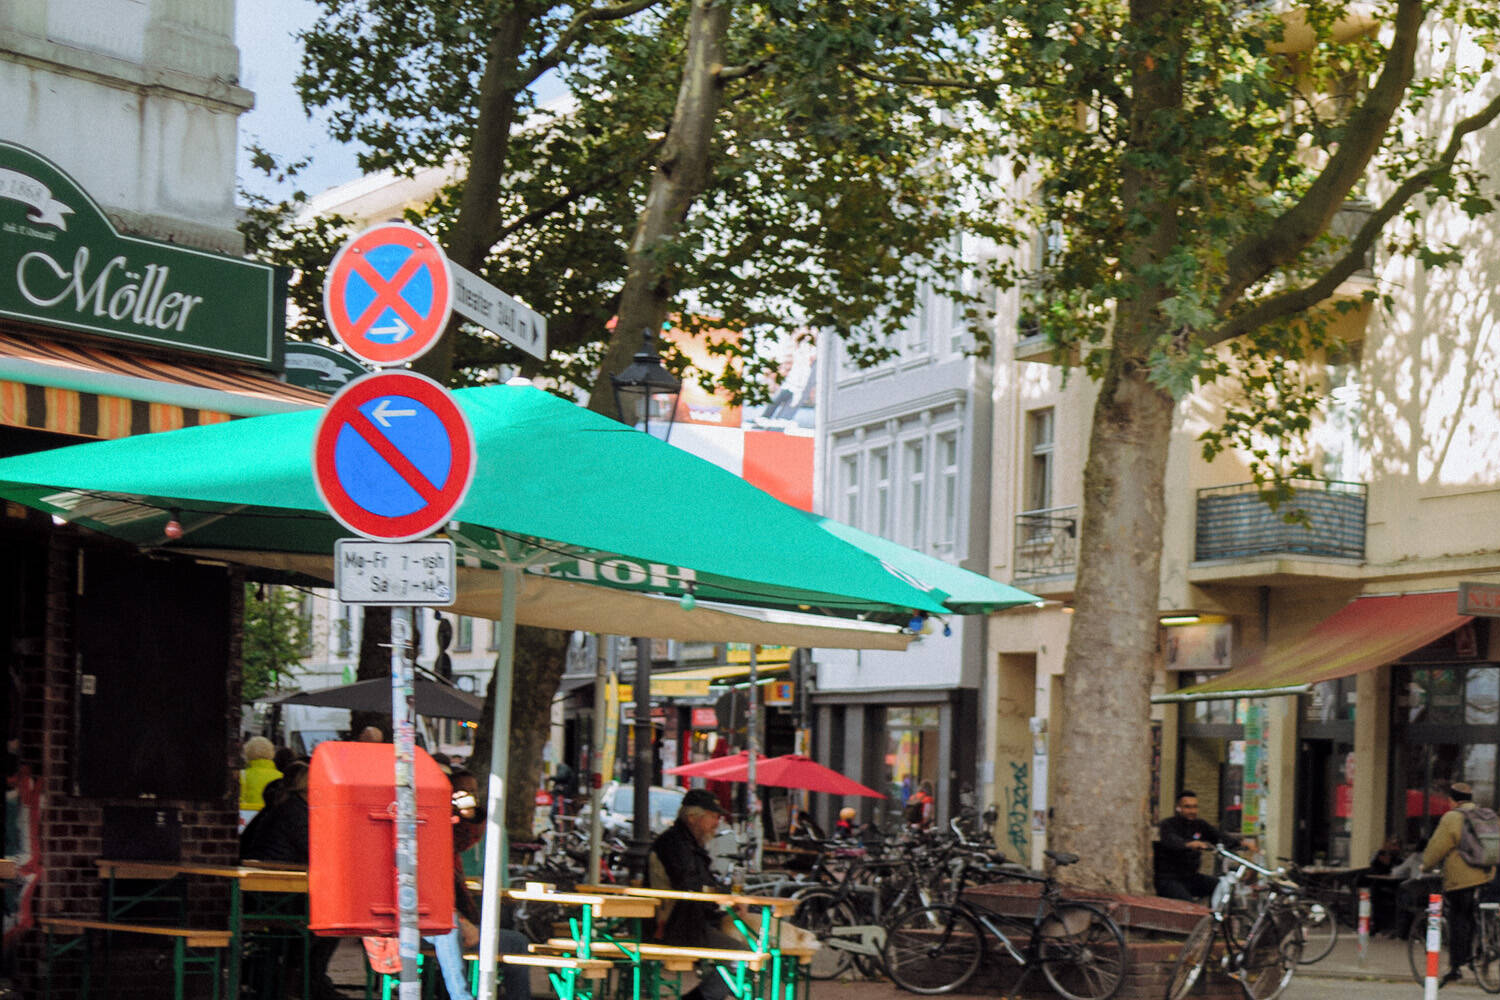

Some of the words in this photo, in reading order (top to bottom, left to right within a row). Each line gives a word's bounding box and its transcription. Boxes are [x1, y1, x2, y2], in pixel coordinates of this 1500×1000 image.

[17, 246, 203, 331] Möller
[344, 551, 388, 569] Mo-Fr
[370, 575, 388, 593] Sa
